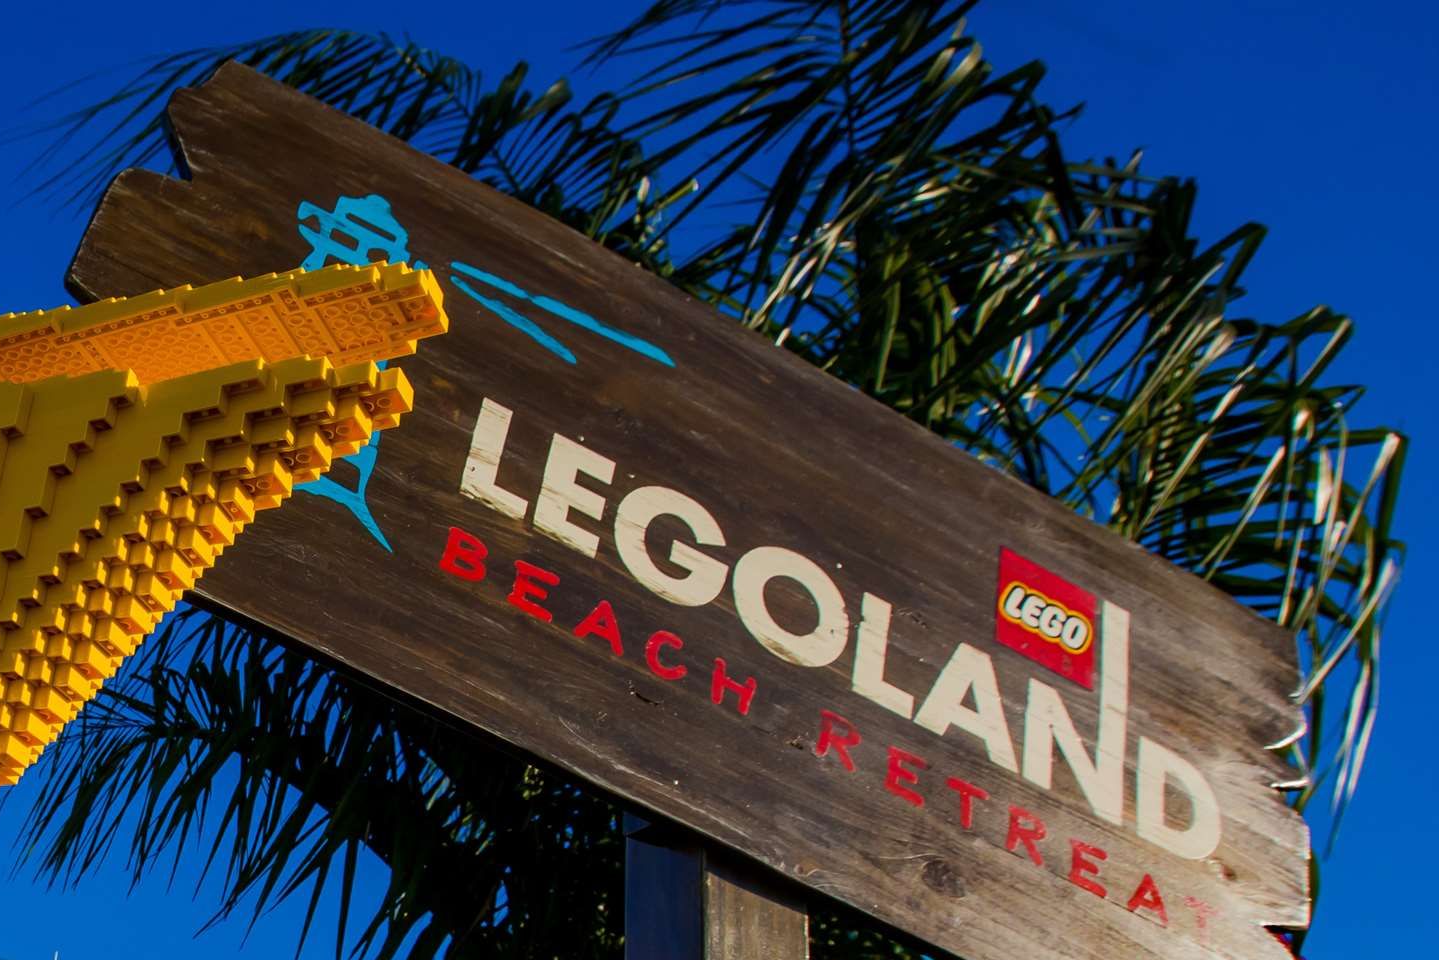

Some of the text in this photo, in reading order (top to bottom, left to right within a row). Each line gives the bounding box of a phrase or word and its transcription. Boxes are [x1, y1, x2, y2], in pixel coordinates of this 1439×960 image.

[439, 526, 1225, 945] BEACH RETREAT
[460, 398, 1221, 860] LEGOLAND
[1003, 585, 1089, 650] LEGO
